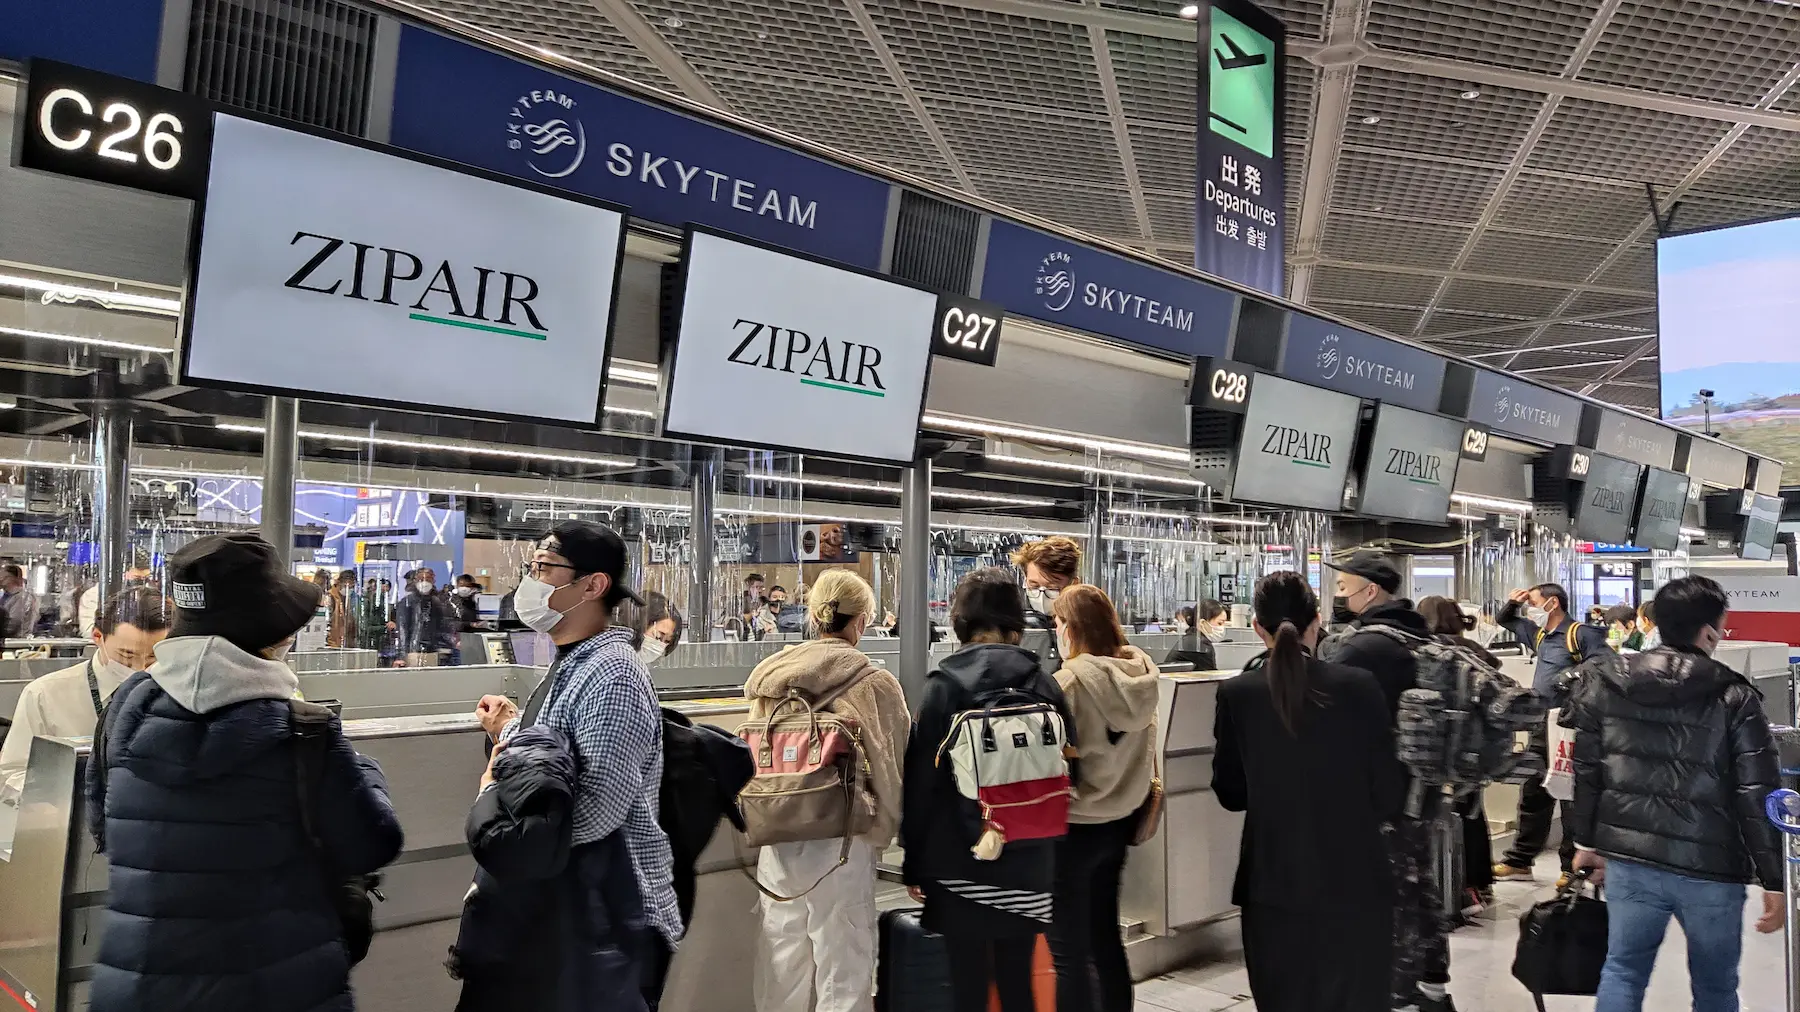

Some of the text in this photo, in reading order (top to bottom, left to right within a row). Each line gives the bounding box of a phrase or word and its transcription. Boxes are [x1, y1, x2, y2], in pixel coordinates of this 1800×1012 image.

[40, 88, 183, 170] C26
[506, 88, 578, 151] SKYTEAM
[605, 143, 819, 230] SKYTEAM
[1221, 154, 1262, 196] 出発
[1204, 179, 1277, 227] Departures
[1216, 214, 1268, 251] 出发 출발
[284, 231, 549, 332] ZIPAIR
[1083, 282, 1194, 333] SKYTEAM
[942, 306, 997, 351] C27
[727, 318, 887, 390] ZIPAIR
[1345, 355, 1415, 391] SKYTEAM
[1211, 368, 1248, 404] C28
[1513, 402, 1561, 428] SKYTEAM
[1261, 424, 1332, 465] ZIPAIR
[1463, 427, 1487, 455] C29
[1385, 447, 1441, 481] ZIPAIR
[1570, 452, 1590, 475] C30
[1591, 486, 1625, 512] ZIPAIR
[1648, 497, 1677, 519] ZIPAIR
[1725, 590, 1780, 598] KYTEAM
